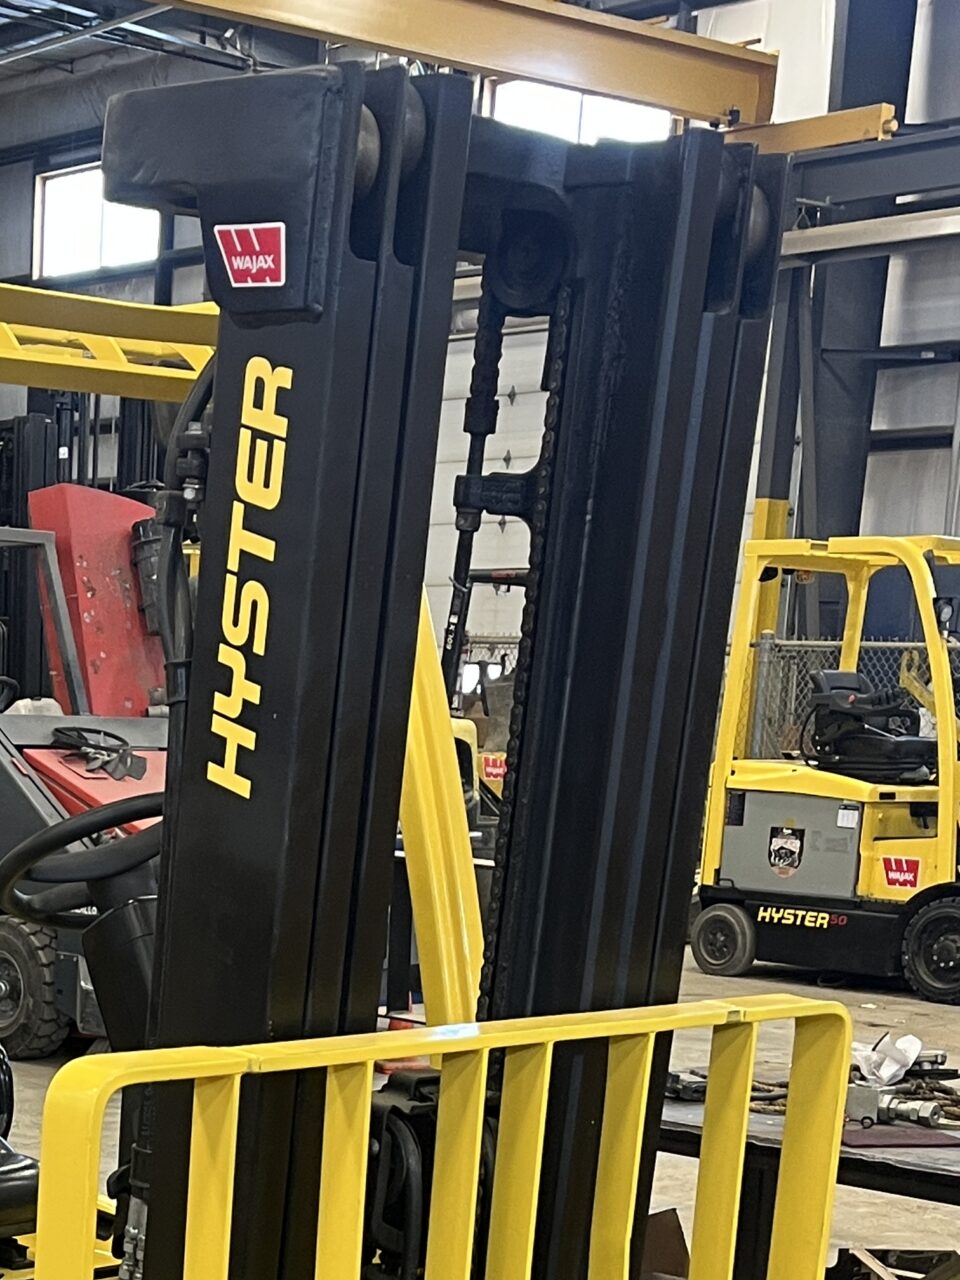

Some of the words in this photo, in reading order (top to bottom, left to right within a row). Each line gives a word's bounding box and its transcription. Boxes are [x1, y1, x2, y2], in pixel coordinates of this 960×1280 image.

[231, 254, 275, 273] WAJAX
[207, 356, 293, 799] HYSTER
[888, 870, 915, 882] WAJAX
[757, 906, 830, 929] HYSTER
[830, 914, 848, 926] 50
